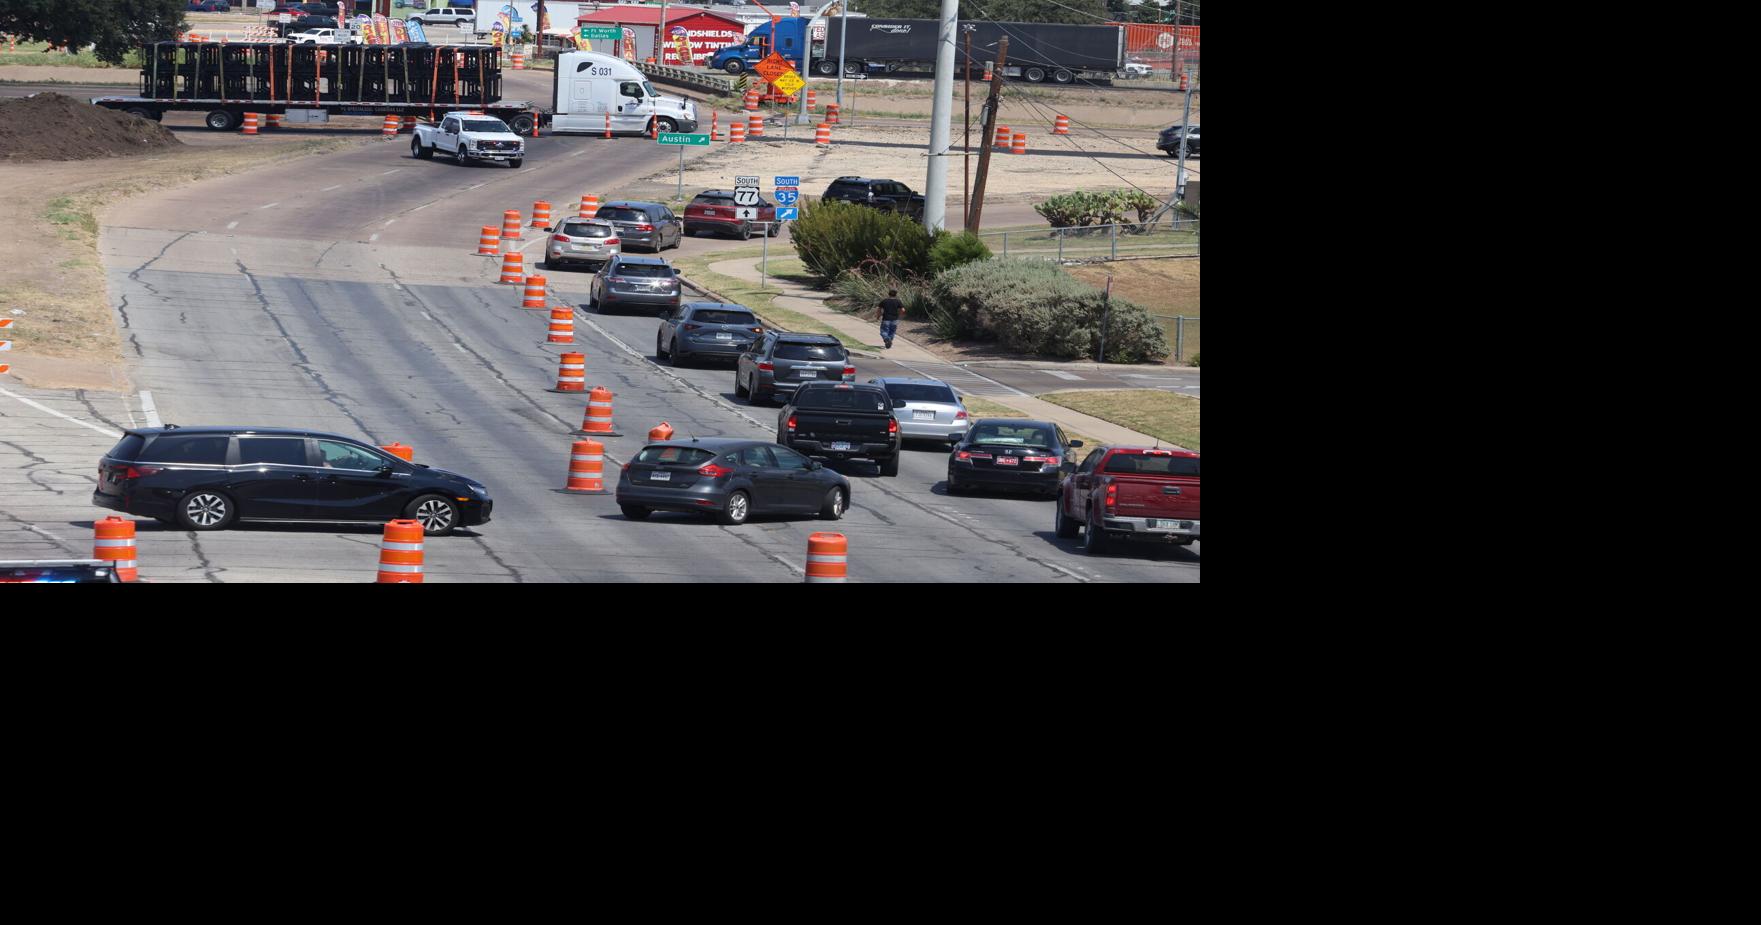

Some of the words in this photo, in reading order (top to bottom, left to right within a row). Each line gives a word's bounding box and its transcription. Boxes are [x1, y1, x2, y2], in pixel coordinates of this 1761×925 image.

[591, 67, 597, 76] S
[599, 67, 612, 76] 031
[776, 177, 798, 185] SOUTH
[737, 190, 756, 202] 77
[778, 192, 796, 203] 35
